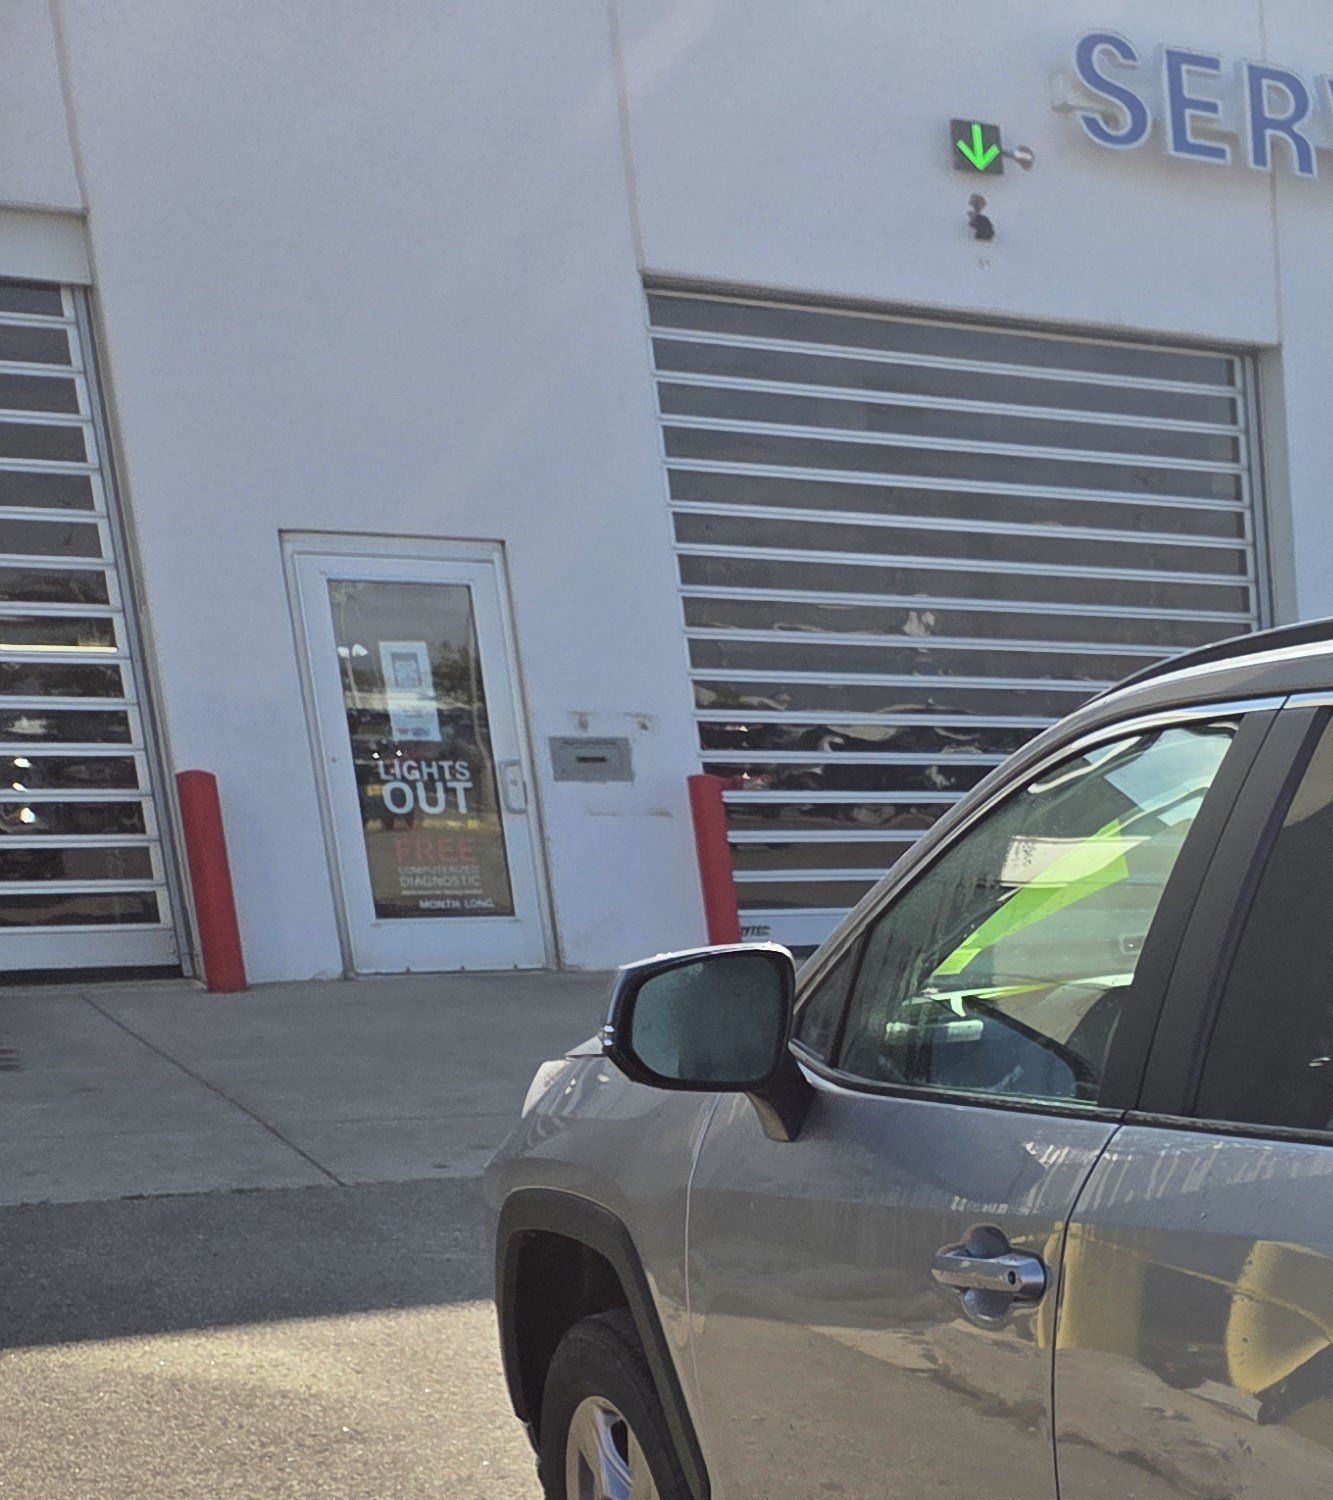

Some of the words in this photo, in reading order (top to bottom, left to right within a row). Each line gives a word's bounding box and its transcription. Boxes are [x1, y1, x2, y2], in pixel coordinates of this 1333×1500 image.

[377, 760, 472, 781] LIGHTS
[381, 781, 473, 815] OUT
[395, 837, 476, 864] FREE
